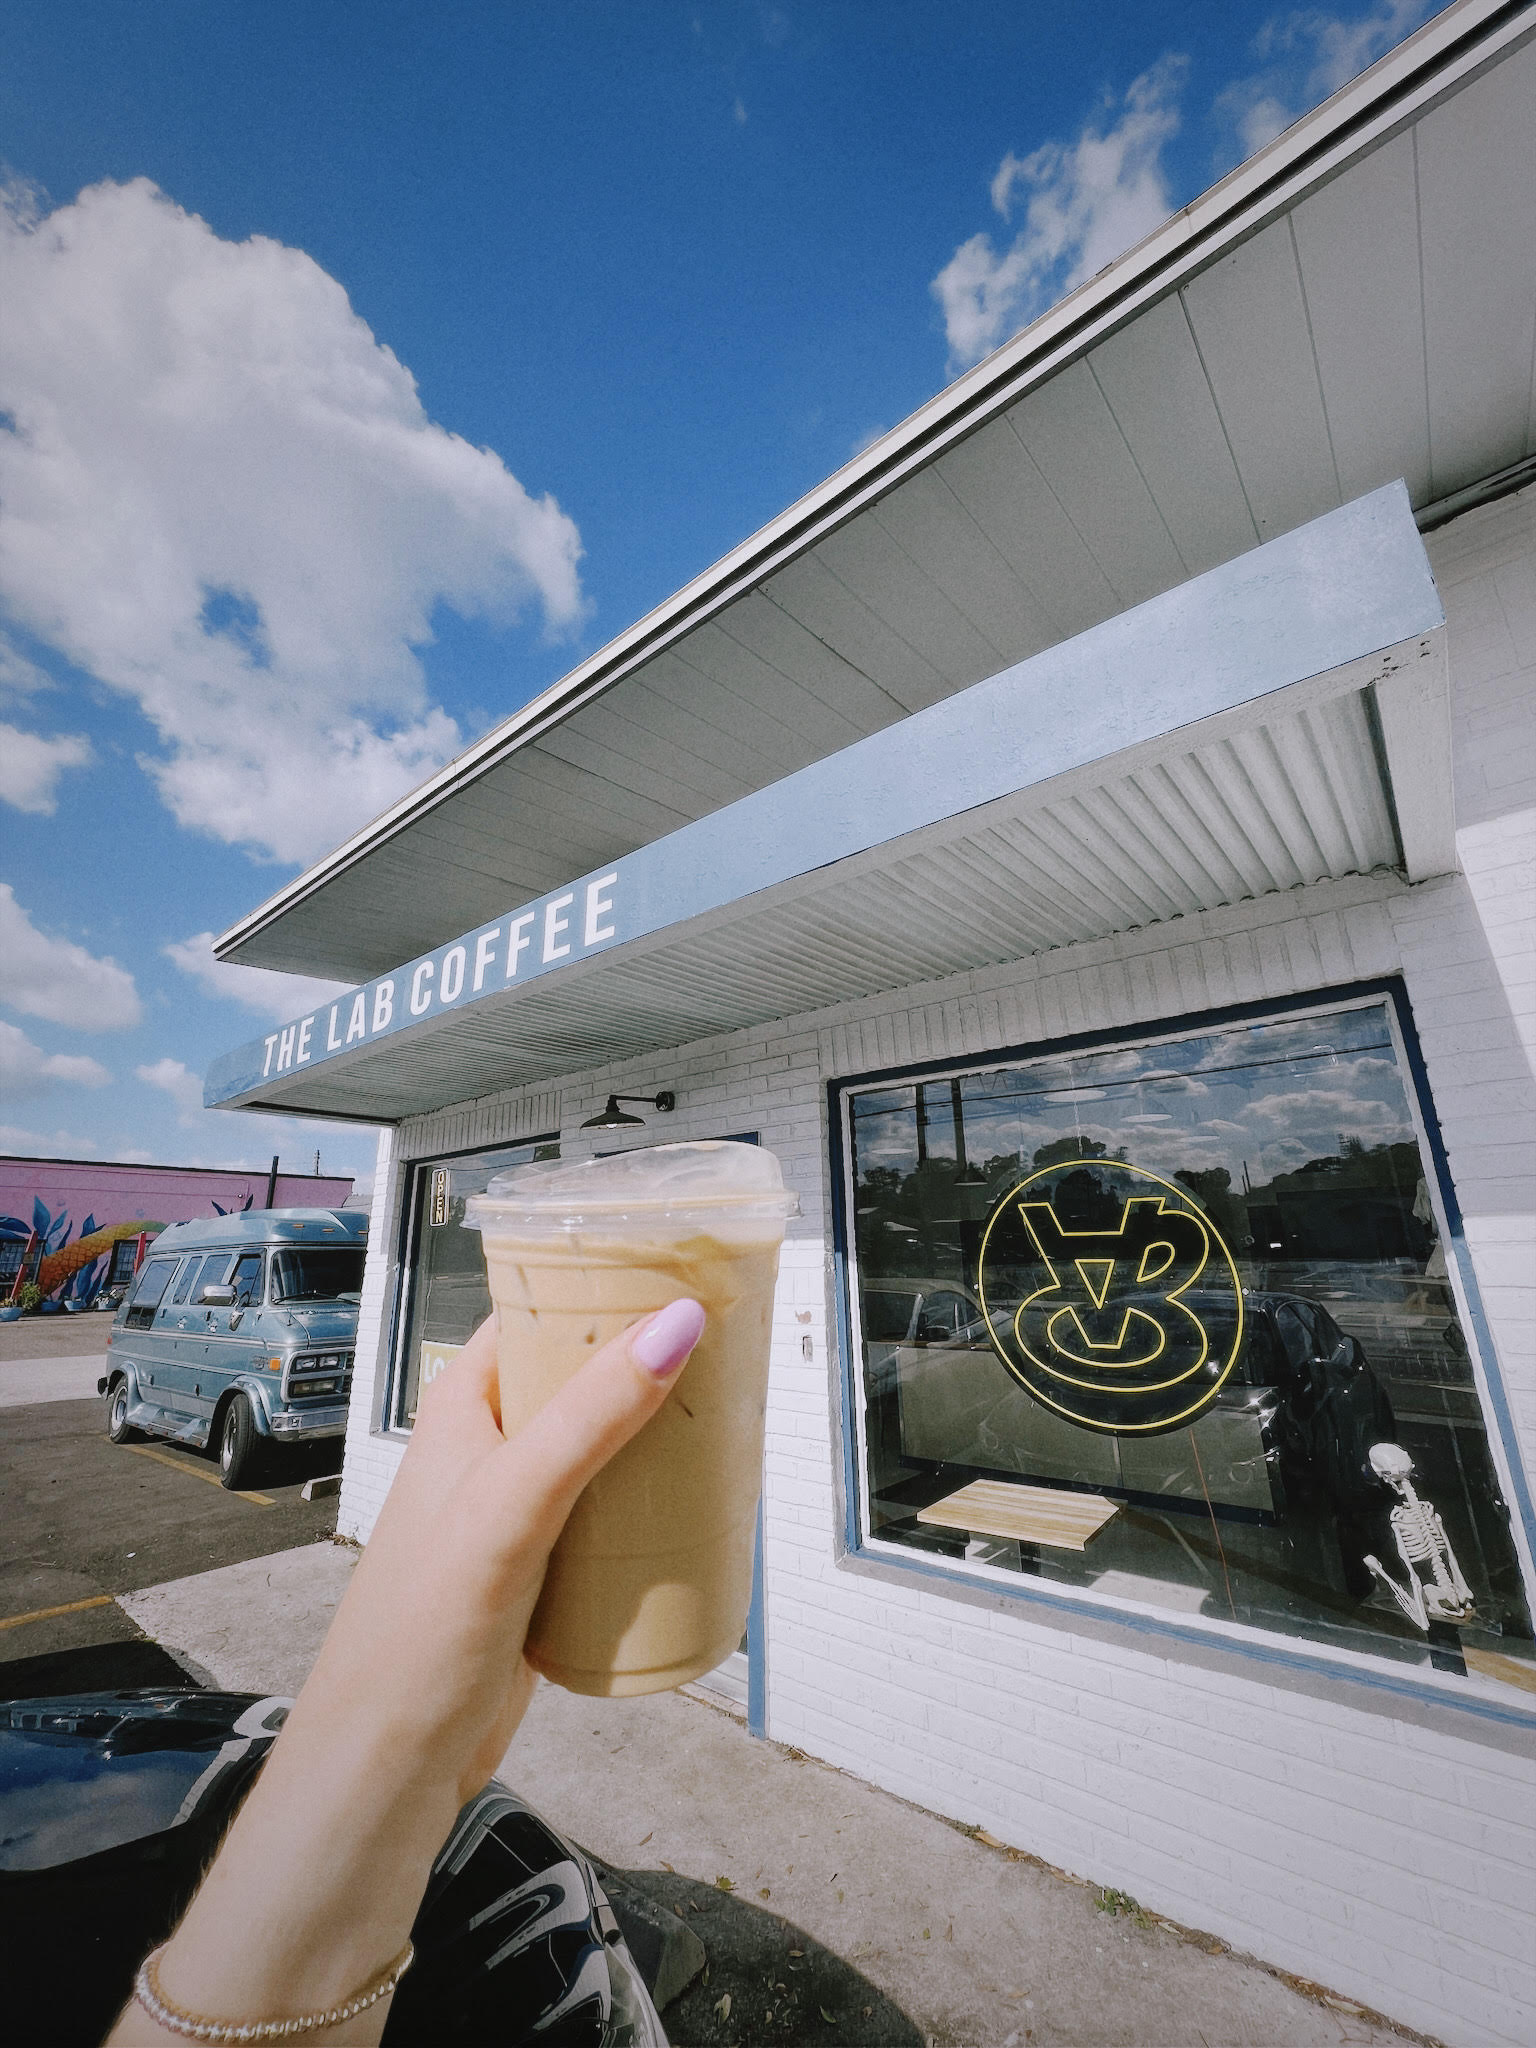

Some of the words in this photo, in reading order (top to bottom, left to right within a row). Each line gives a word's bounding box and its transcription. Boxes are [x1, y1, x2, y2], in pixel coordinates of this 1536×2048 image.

[263, 1016, 315, 1077] THE
[327, 979, 395, 1052] LAB
[410, 872, 618, 1016] COFFEE
[435, 1170, 445, 1224] OPEN
